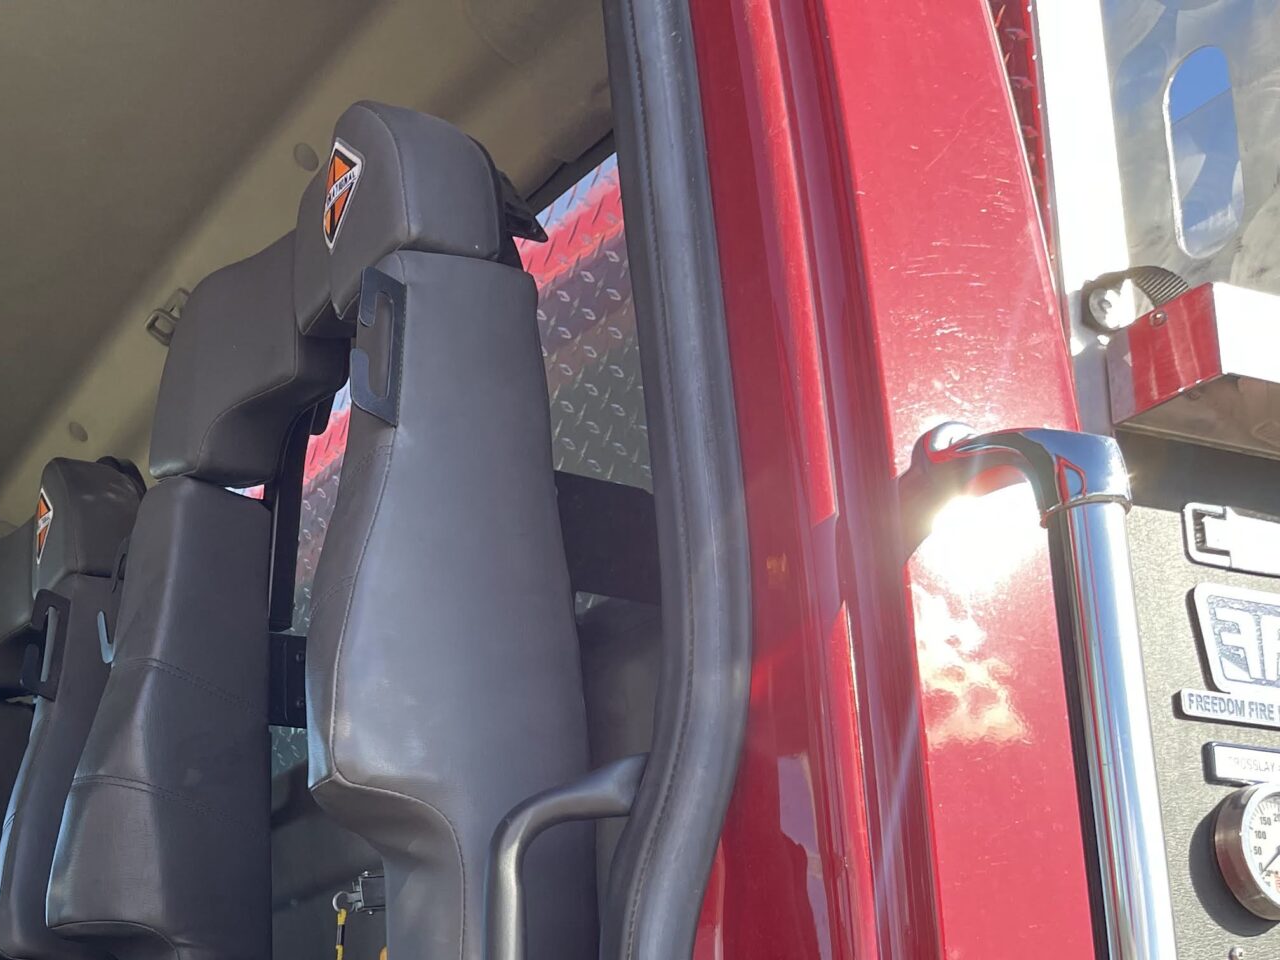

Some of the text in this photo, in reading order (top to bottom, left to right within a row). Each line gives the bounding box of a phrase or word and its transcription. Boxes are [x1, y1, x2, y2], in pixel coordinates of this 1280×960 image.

[1187, 693, 1275, 721] FREEDOM FIRE
[1228, 756, 1275, 772] ROSSLAY
[1259, 816, 1271, 825] 150
[1254, 830, 1266, 839] 100
[1253, 846, 1262, 855] 50
